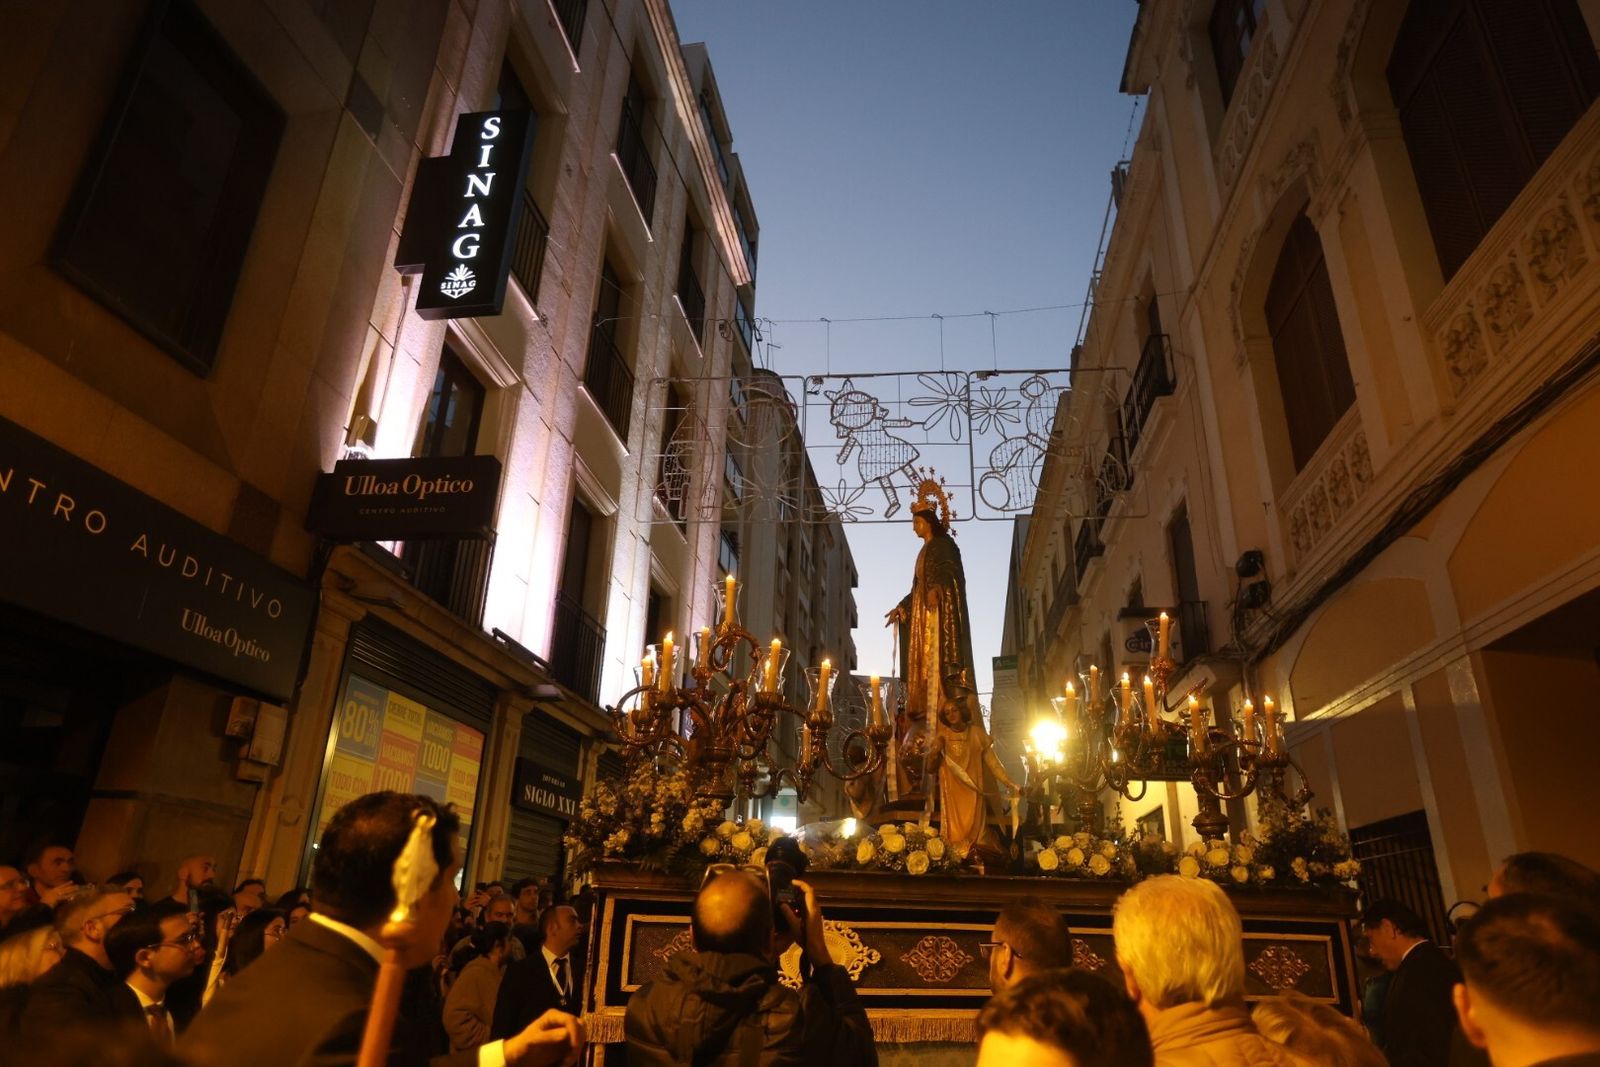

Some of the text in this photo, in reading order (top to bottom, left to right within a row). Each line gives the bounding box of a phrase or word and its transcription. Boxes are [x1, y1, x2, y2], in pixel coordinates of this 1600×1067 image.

[451, 115, 501, 260] SINAG
[440, 280, 476, 290] SINAG
[130, 533, 283, 619] AUDITIVO
[422, 740, 450, 773] TODO
[524, 784, 576, 816] SIGLO XXI
